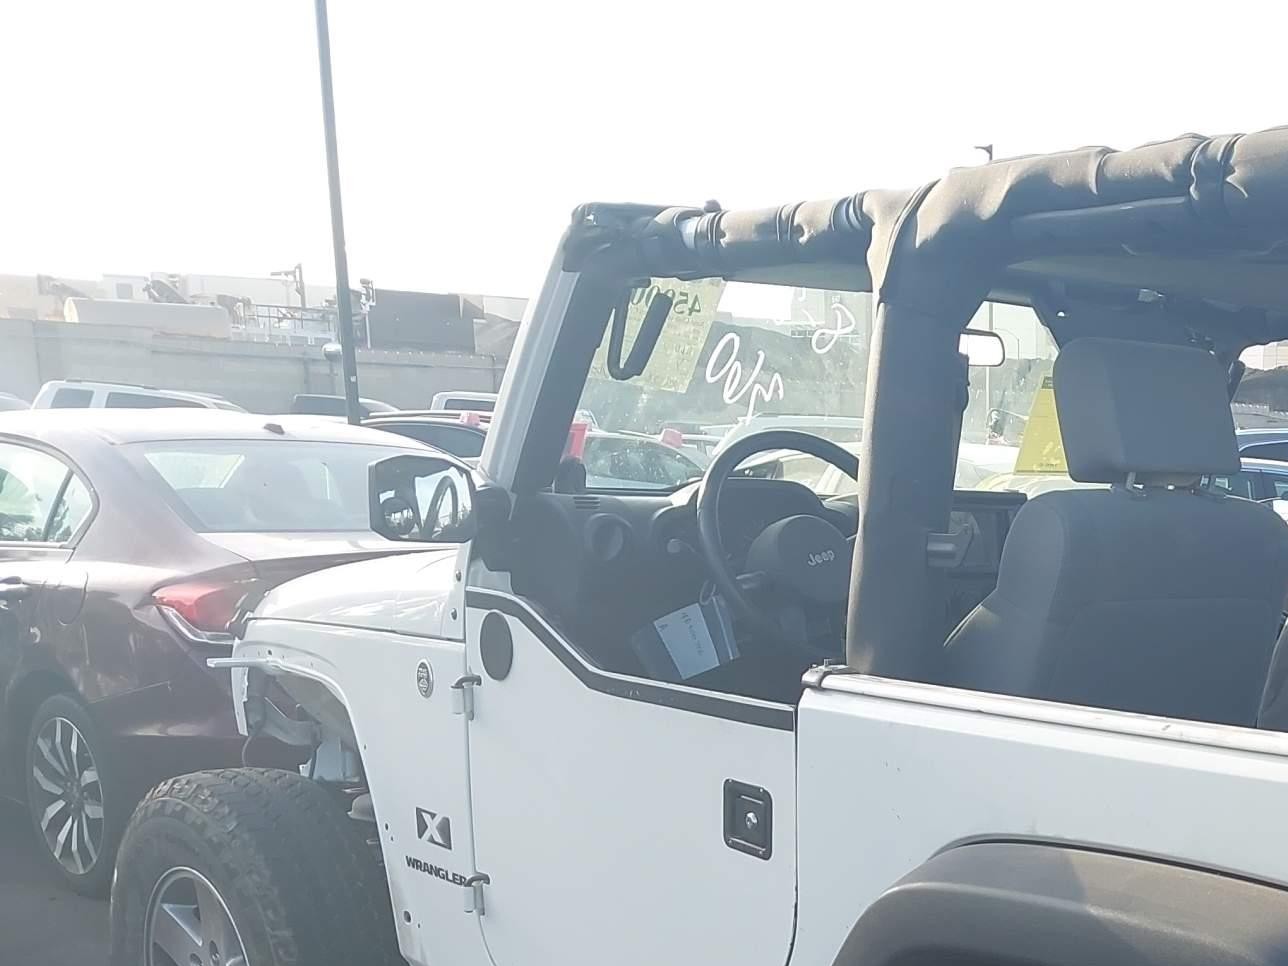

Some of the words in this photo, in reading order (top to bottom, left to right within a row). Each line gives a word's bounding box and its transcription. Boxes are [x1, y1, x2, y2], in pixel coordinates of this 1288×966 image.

[808, 550, 835, 566] Jeep
[417, 808, 450, 849] X
[405, 855, 469, 887] WRANGLER
